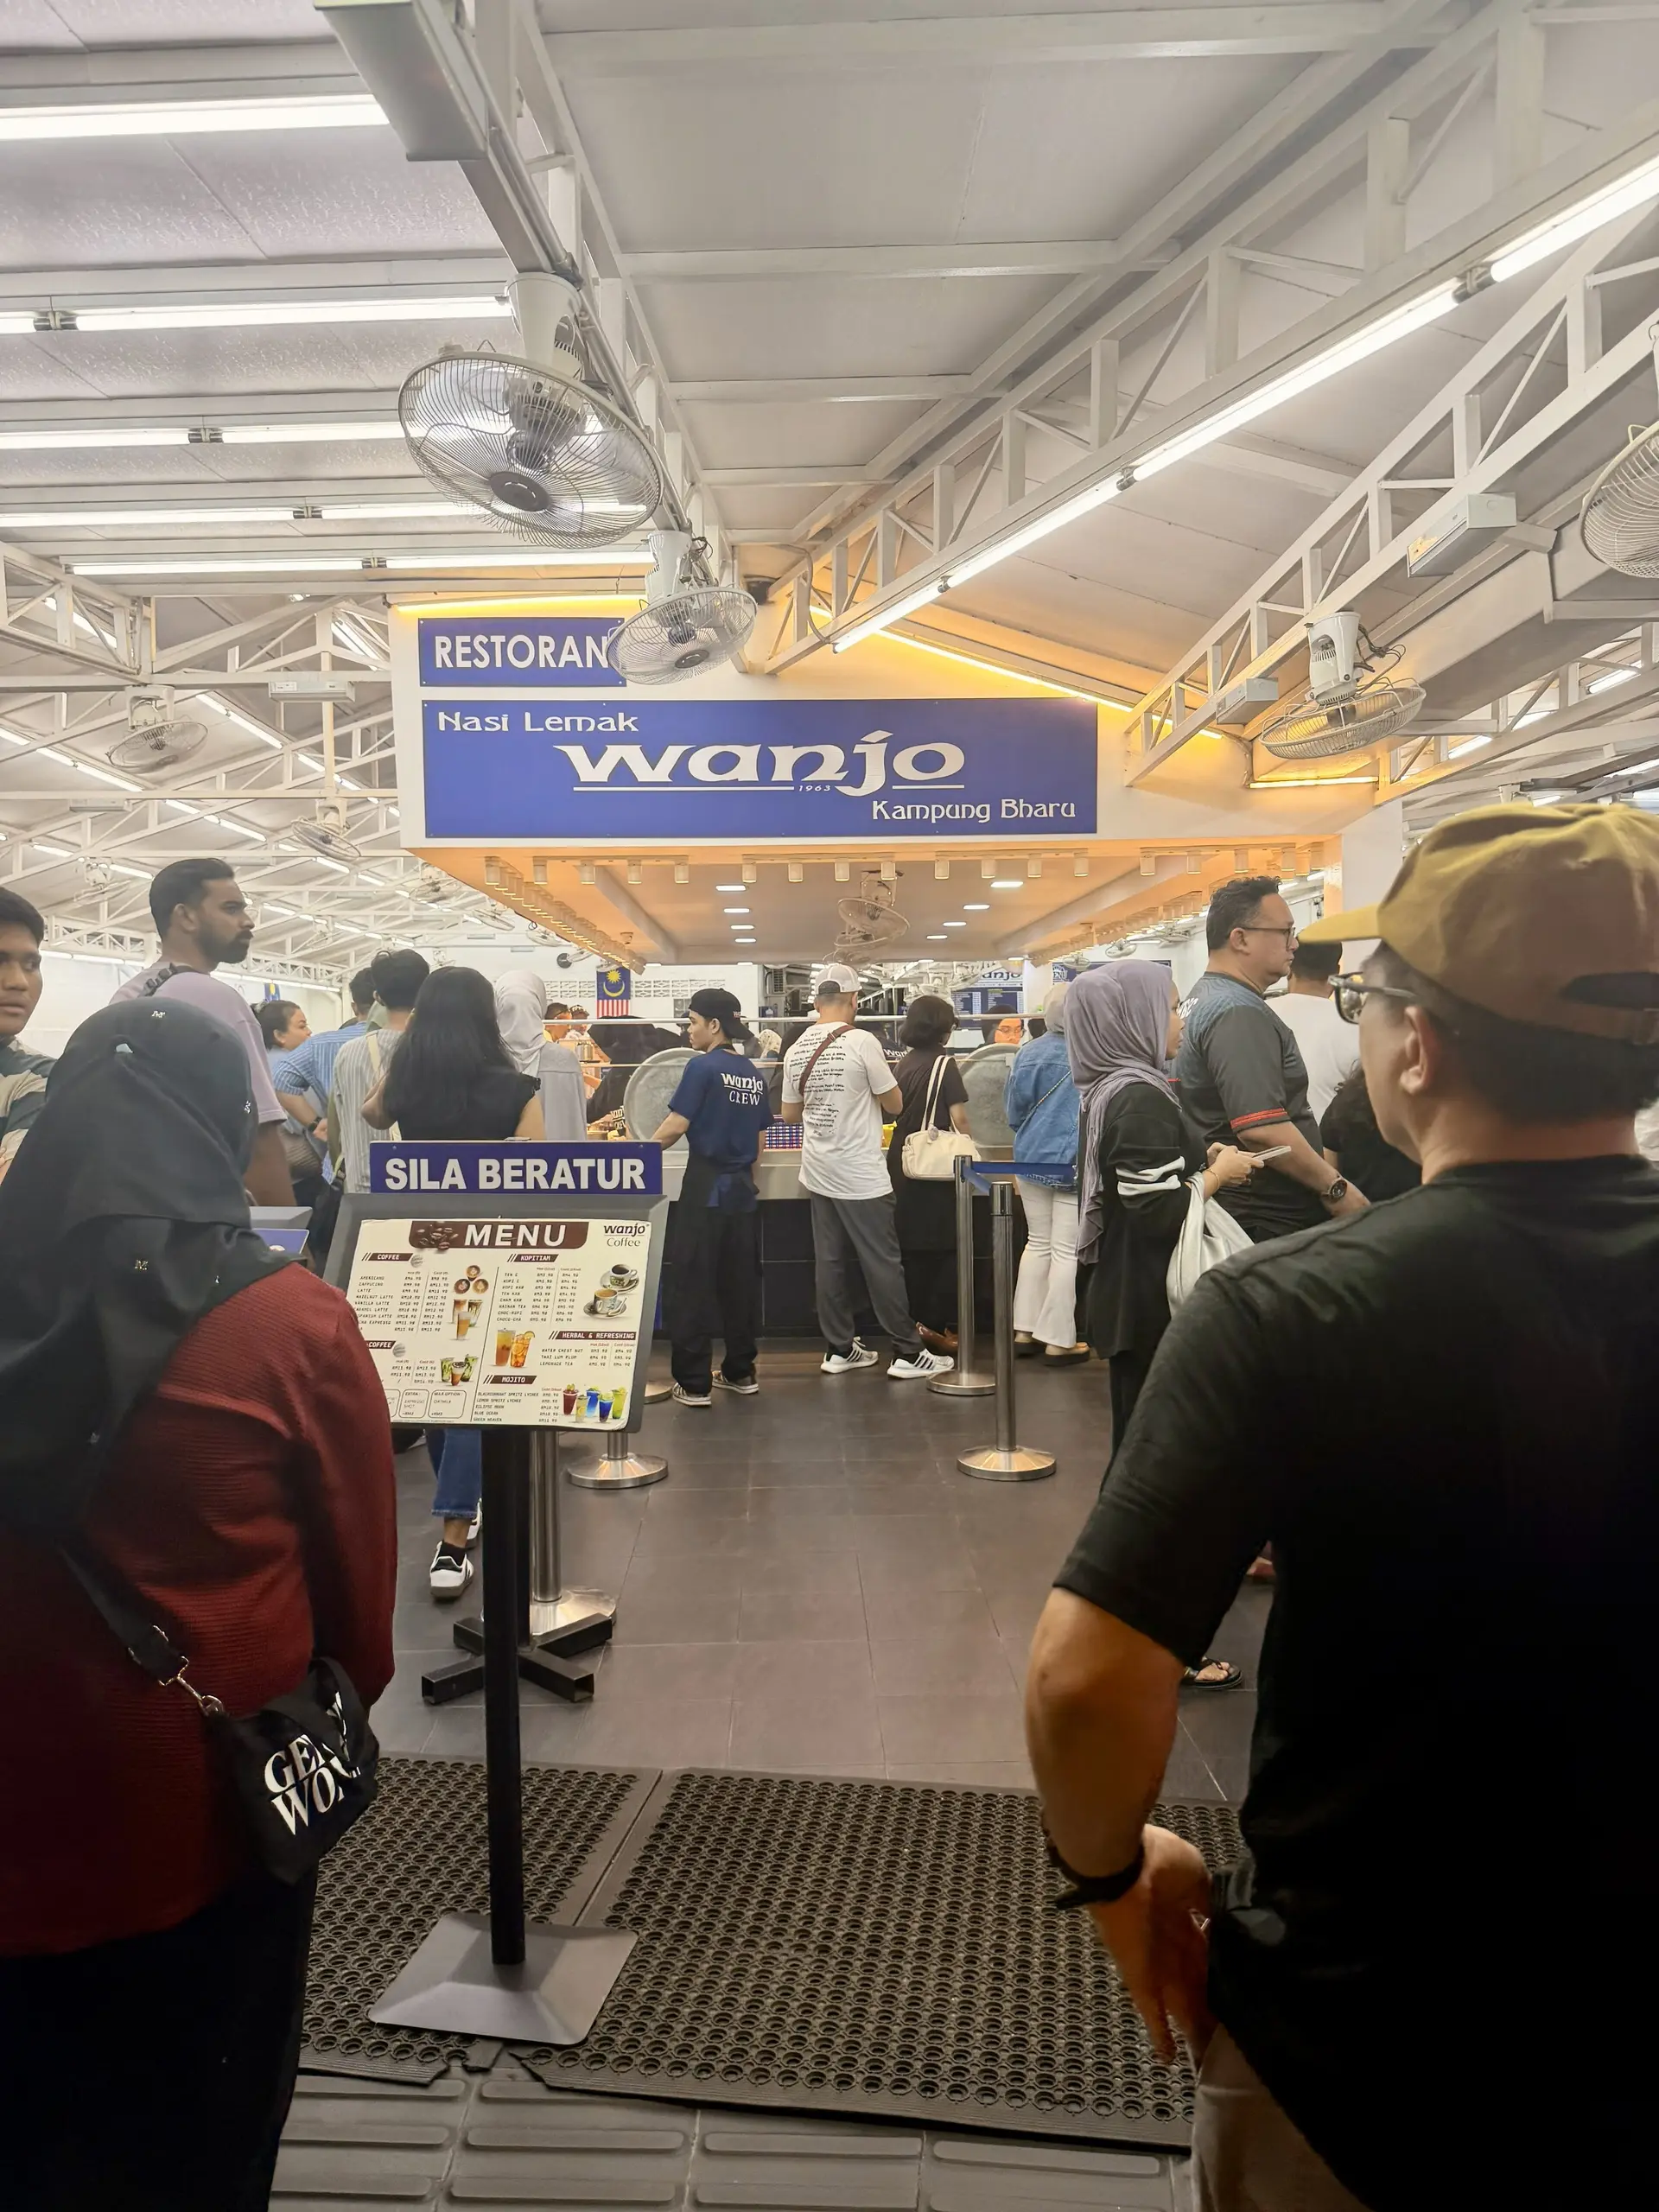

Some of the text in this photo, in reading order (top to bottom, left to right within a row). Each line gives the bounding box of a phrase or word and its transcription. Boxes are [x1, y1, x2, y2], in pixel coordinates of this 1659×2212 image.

[435, 634, 609, 669] RESTORAN
[438, 711, 640, 733] Nasi Lemak
[798, 784, 832, 793] 1963
[872, 797, 1076, 823] Kampung Bharu
[729, 1090, 760, 1105] CREW
[385, 1158, 645, 1191] SILA BERATUR
[464, 1224, 566, 1247] MENU
[607, 1237, 641, 1247] Coffee
